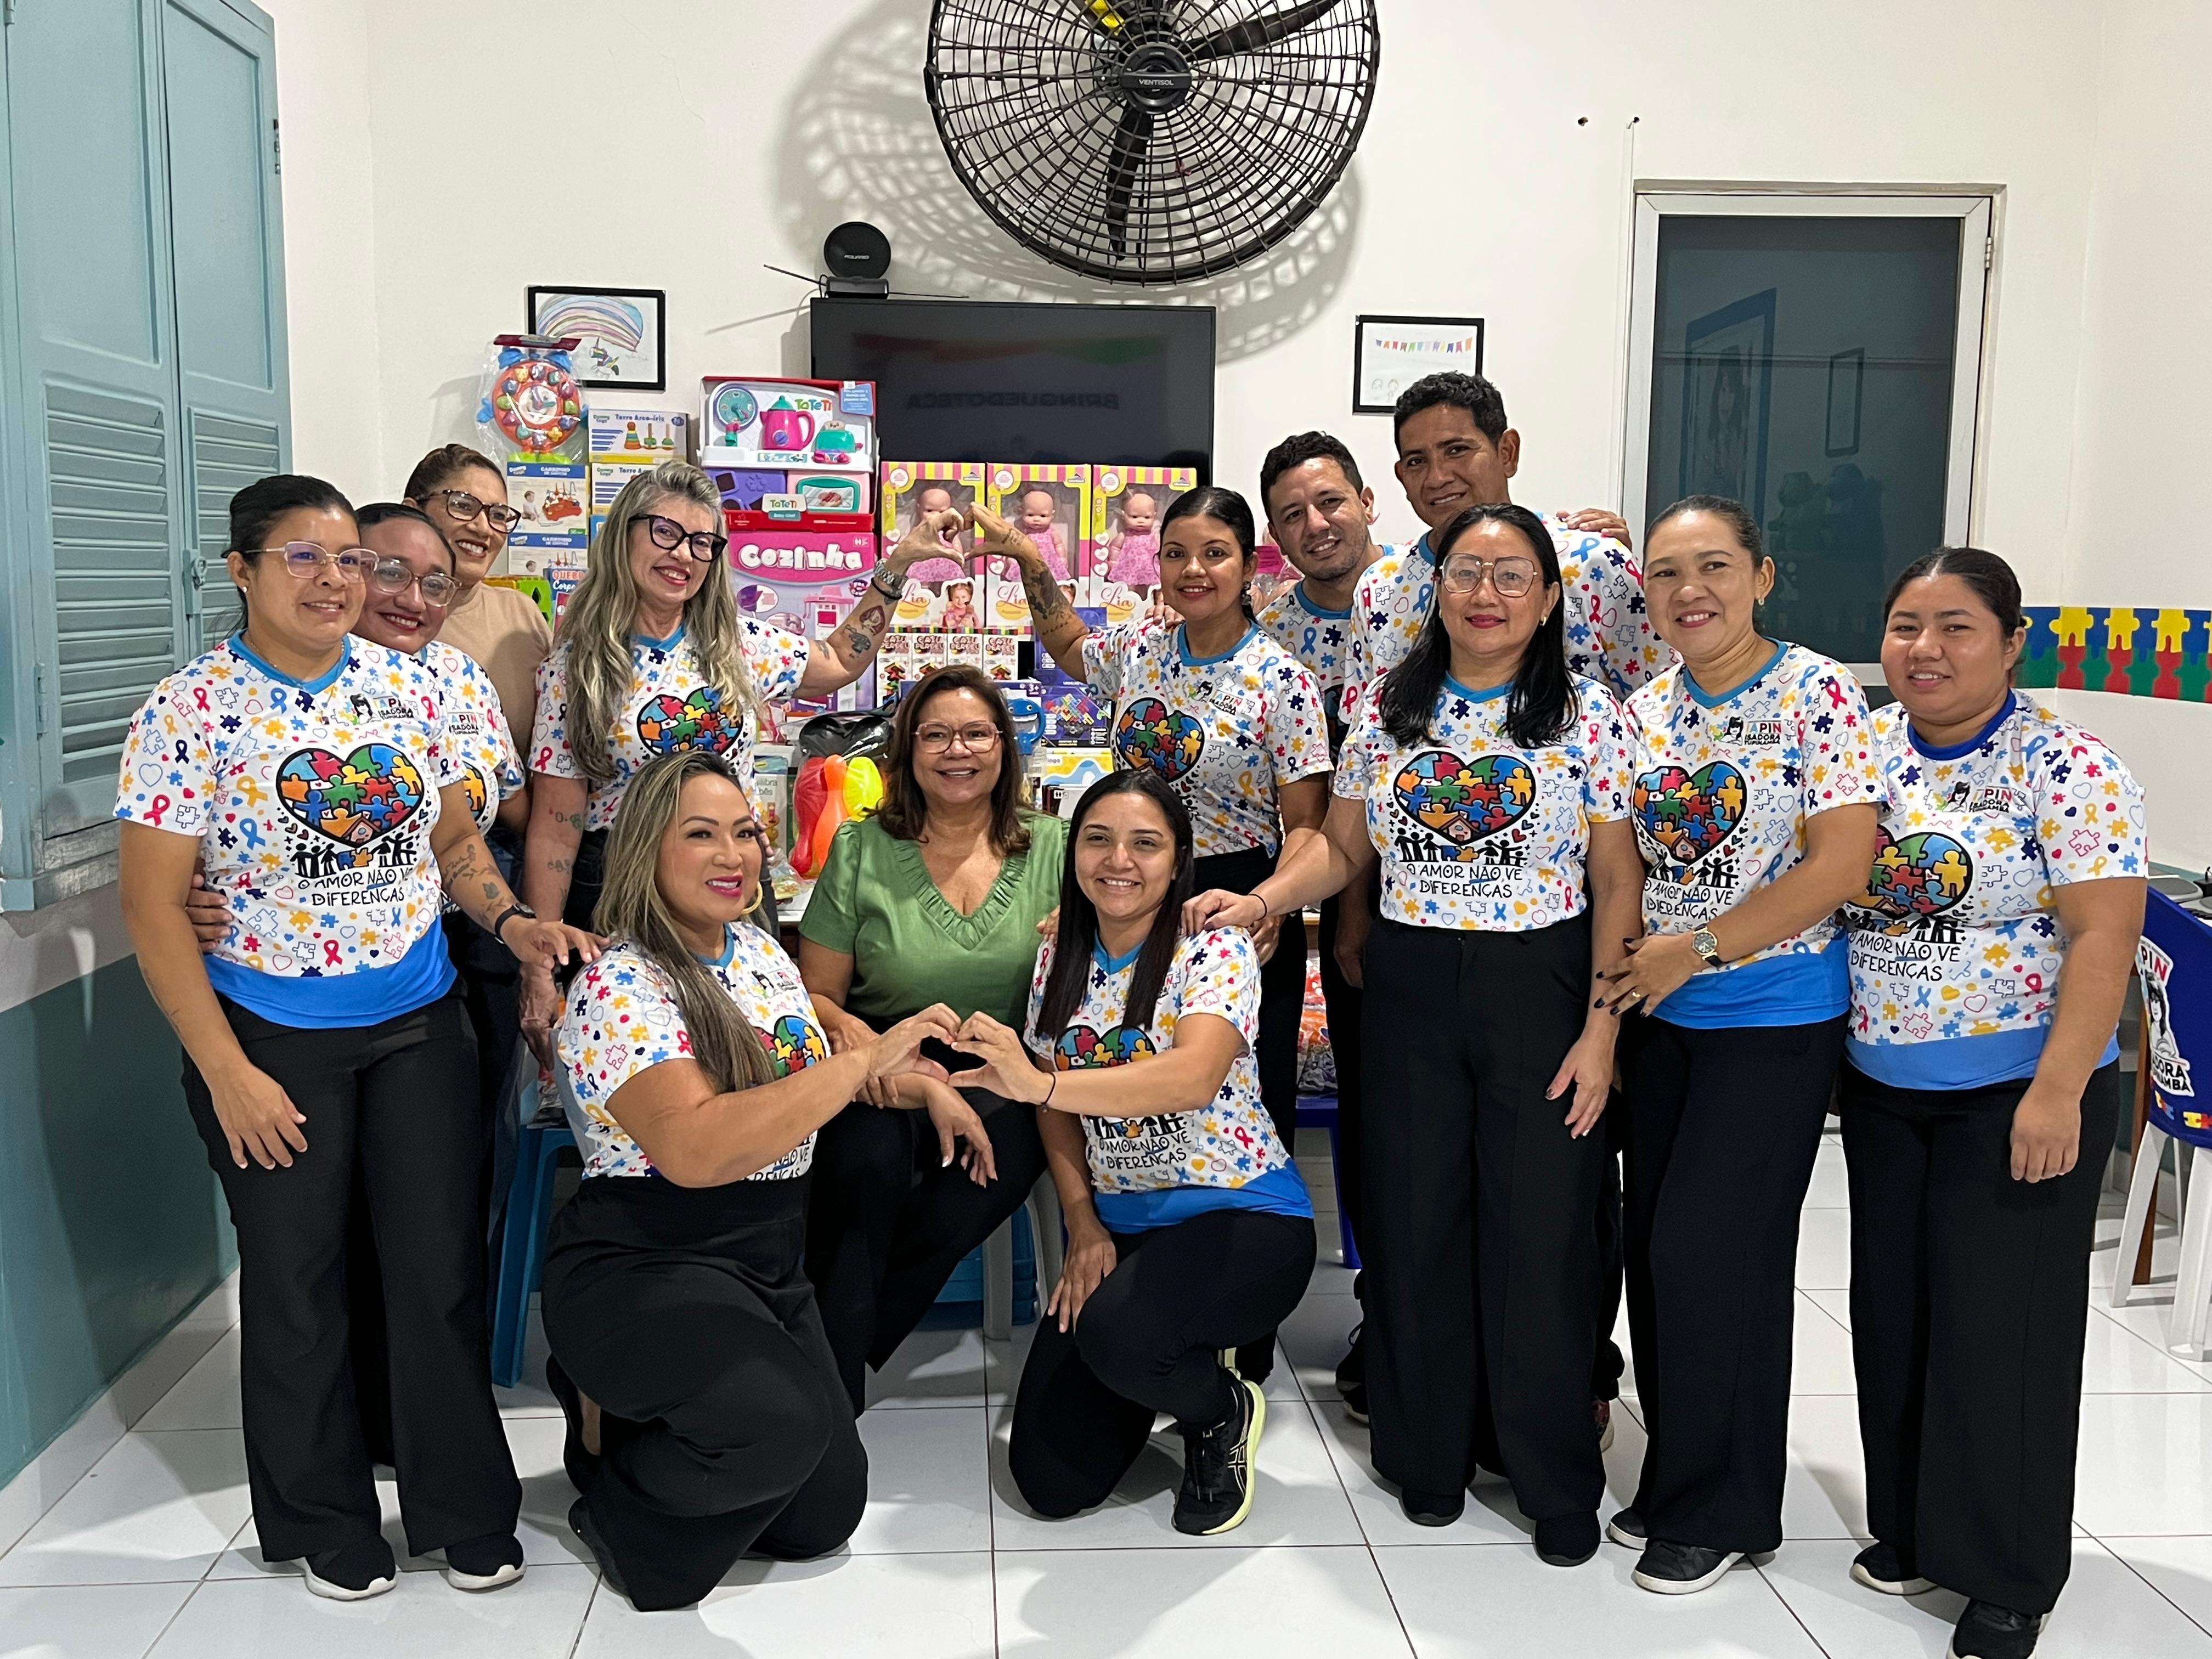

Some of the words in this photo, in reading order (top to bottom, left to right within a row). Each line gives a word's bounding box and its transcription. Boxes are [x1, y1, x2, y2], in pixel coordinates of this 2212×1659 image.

[739, 544, 863, 571] Cozinha
[1099, 586, 1136, 611] Lia
[298, 879, 309, 889] O
[314, 873, 363, 888] AMOR
[1407, 864, 1415, 874] O
[1420, 865, 1464, 878] AMOR
[1849, 929, 1858, 943] O
[1856, 933, 1892, 953] AMOR
